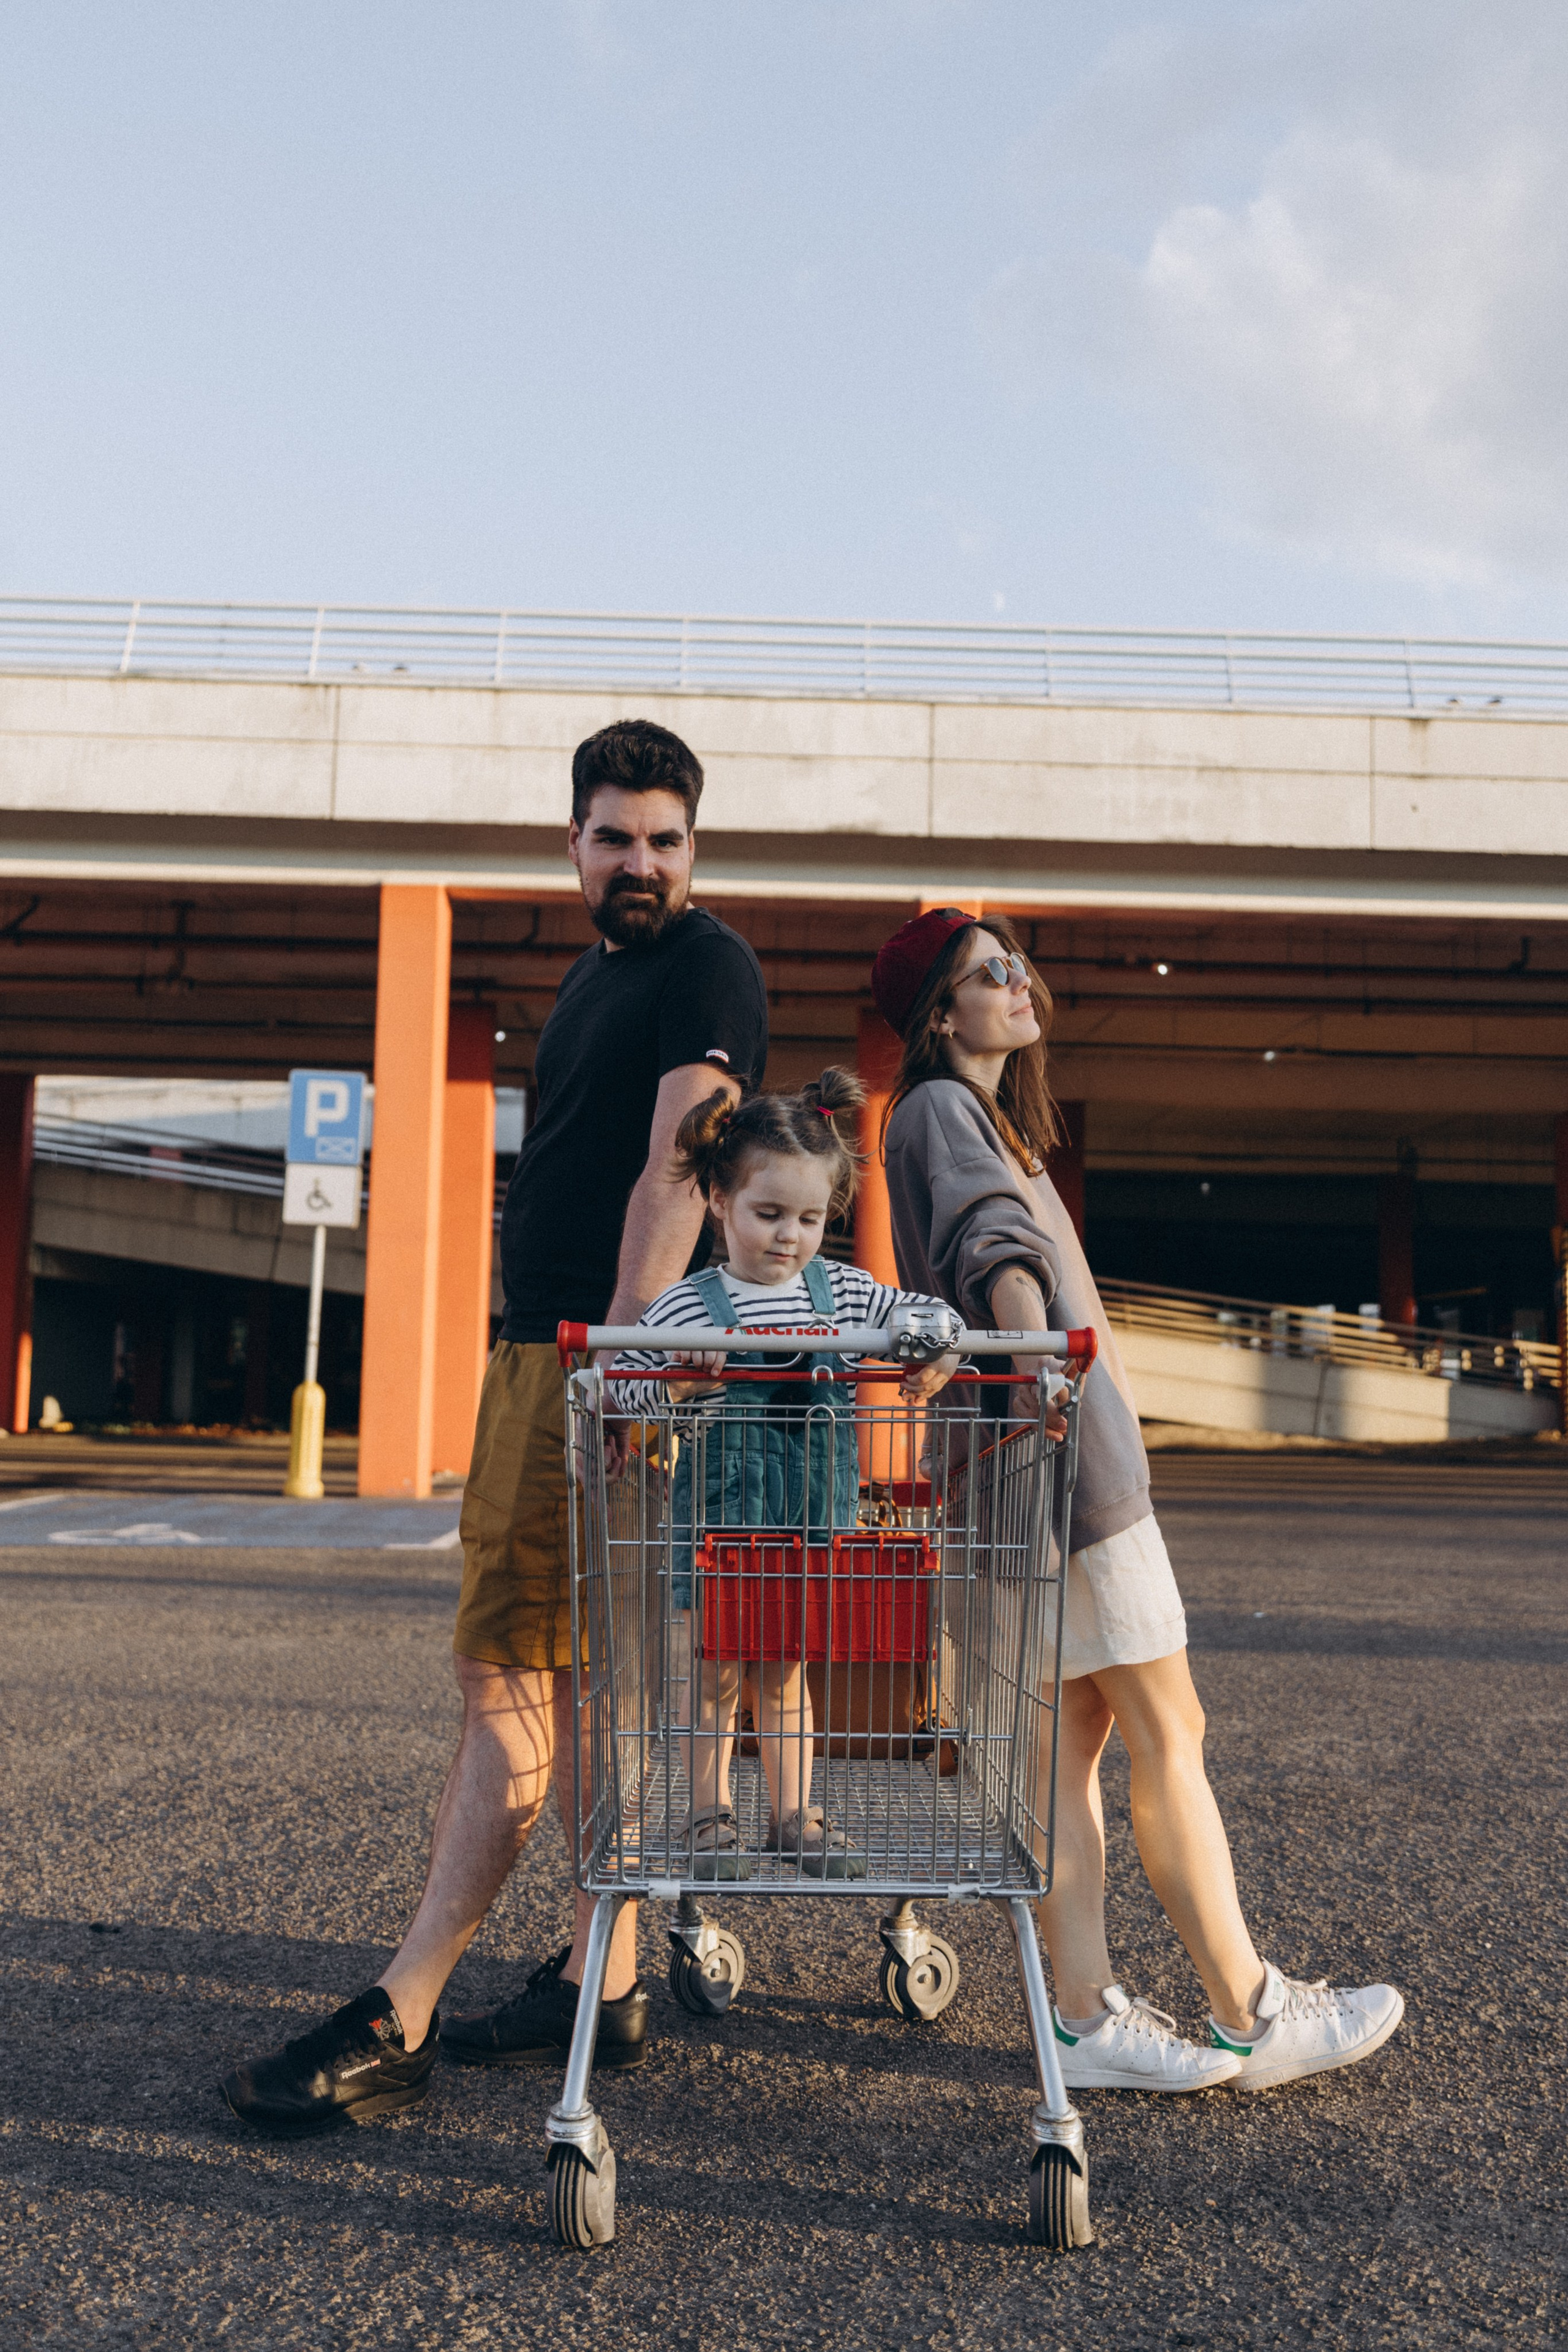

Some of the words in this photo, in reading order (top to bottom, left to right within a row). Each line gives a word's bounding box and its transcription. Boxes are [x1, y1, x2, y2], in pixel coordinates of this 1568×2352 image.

[304, 1079, 349, 1137] P
[390, 2009, 403, 2035] Reebok
[341, 2062, 371, 2079] Reebok
